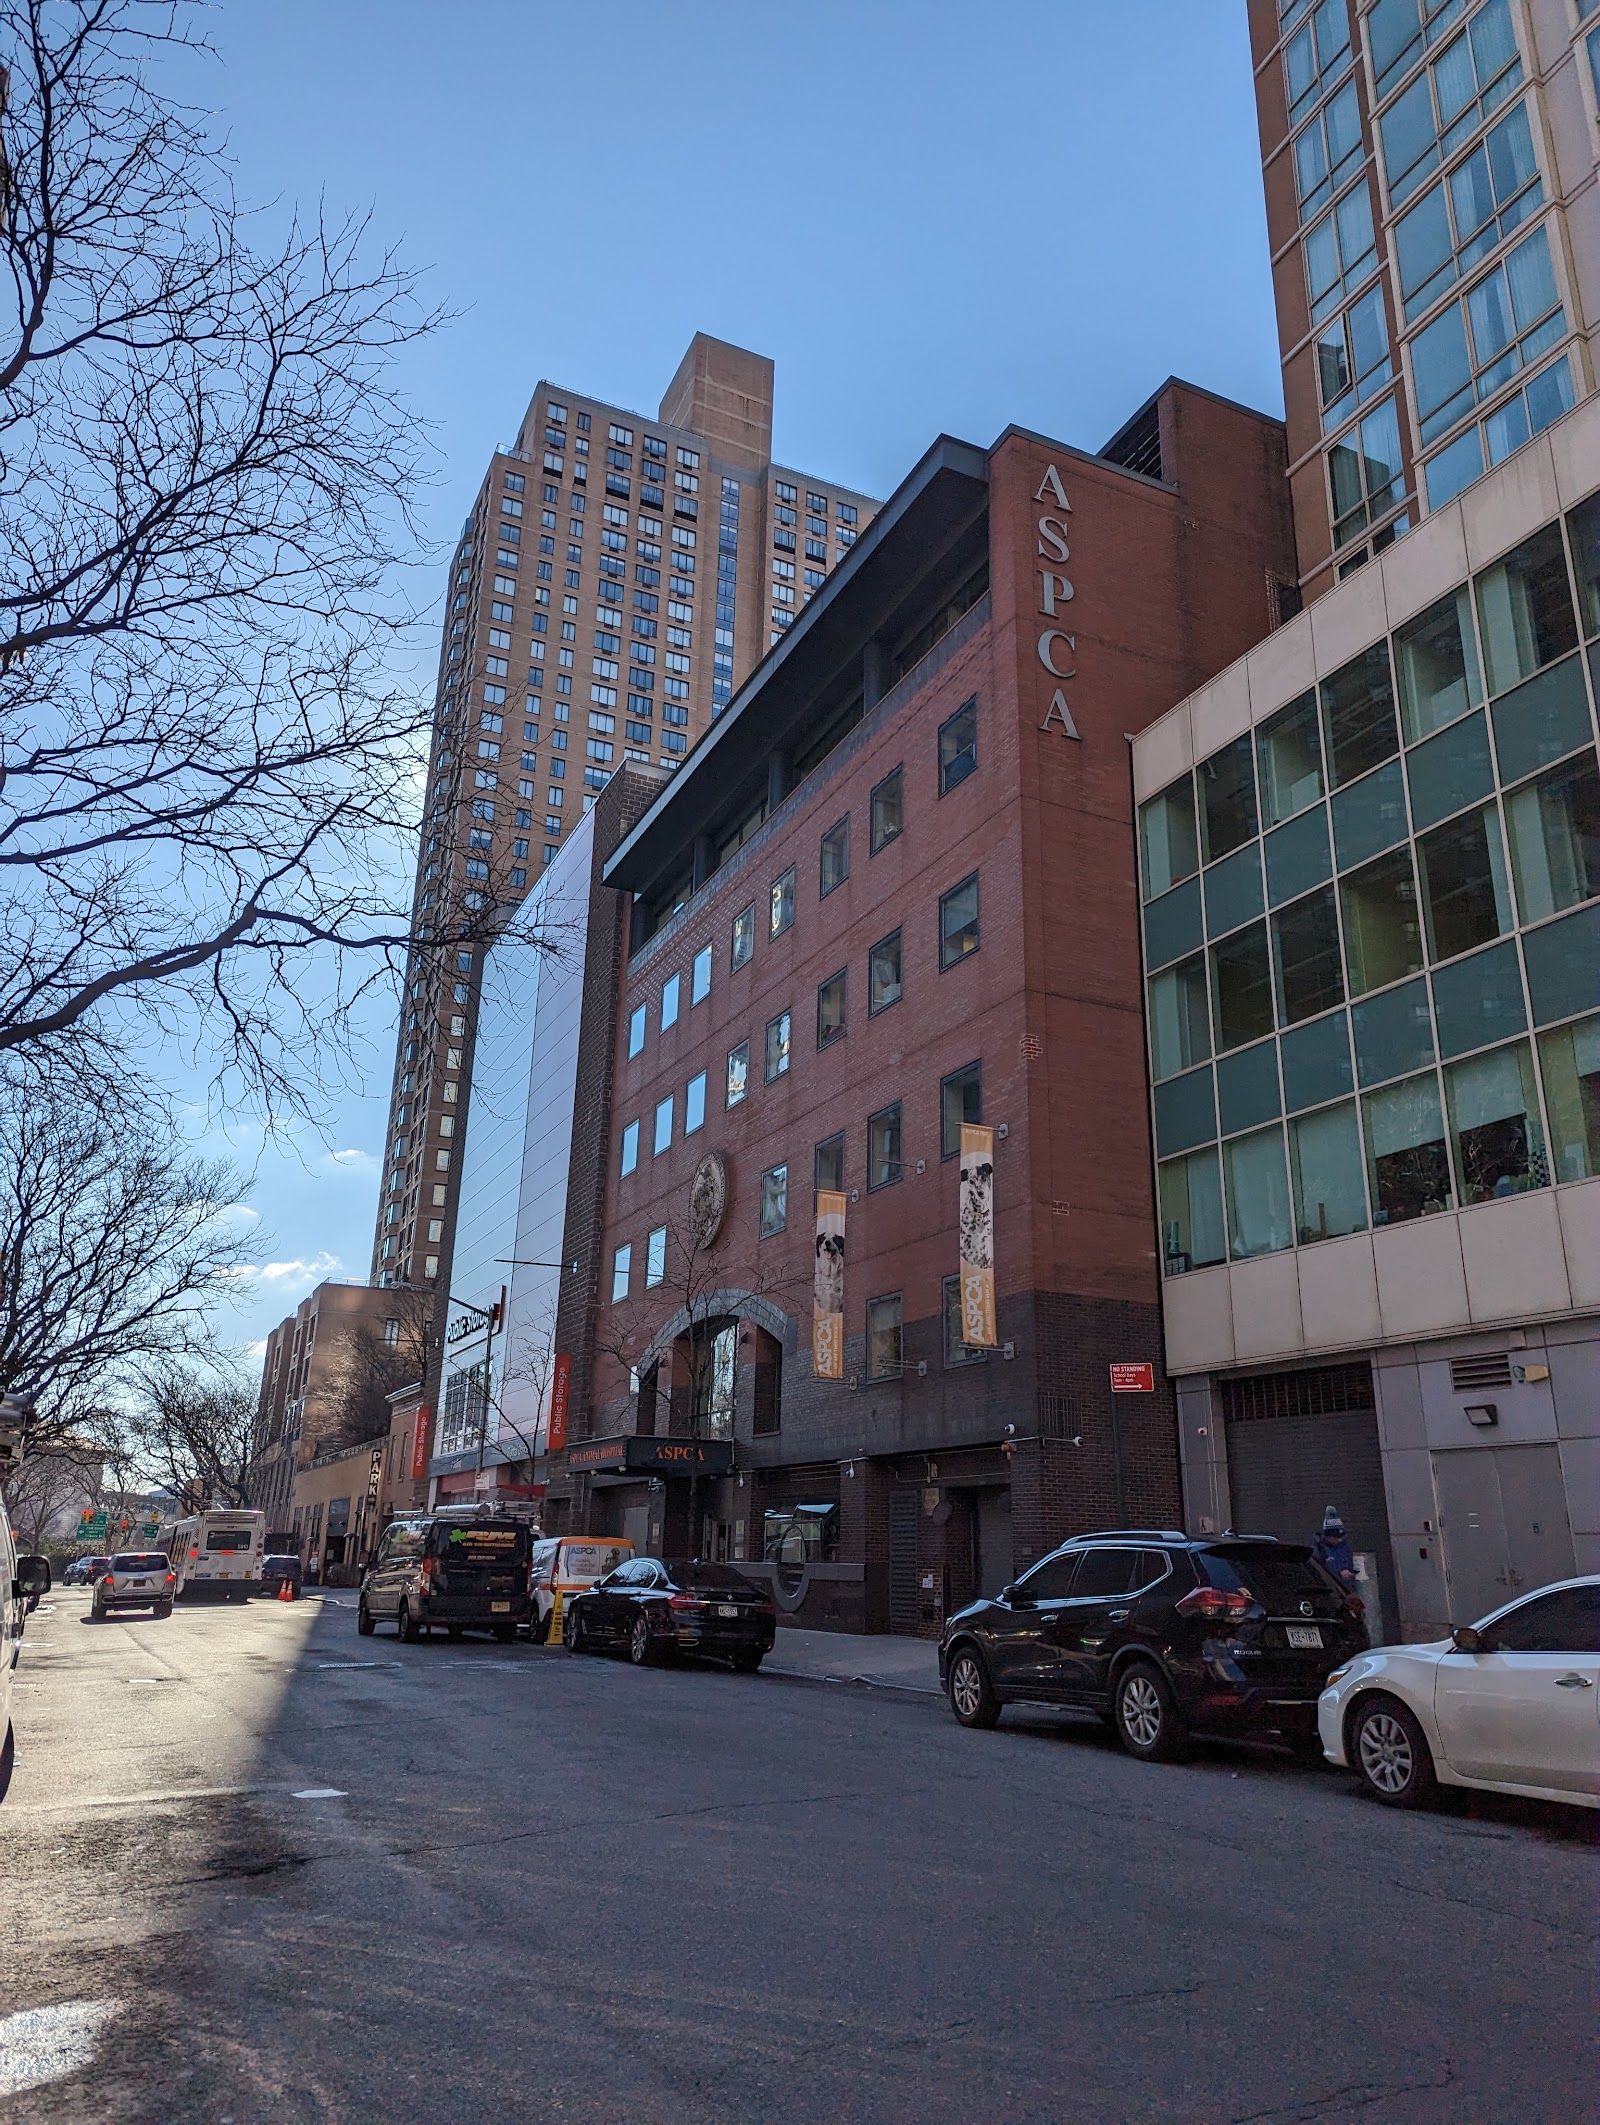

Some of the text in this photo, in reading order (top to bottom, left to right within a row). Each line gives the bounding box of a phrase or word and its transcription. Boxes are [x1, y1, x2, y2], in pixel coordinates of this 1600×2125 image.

[1032, 464, 1081, 740] ASPCA
[965, 1275, 985, 1343] ASPCA
[817, 1318, 832, 1376] ASPCA
[553, 1367, 566, 1434] Public Storage
[416, 1416, 428, 1467] Public Storage
[368, 1451, 381, 1496] PARK
